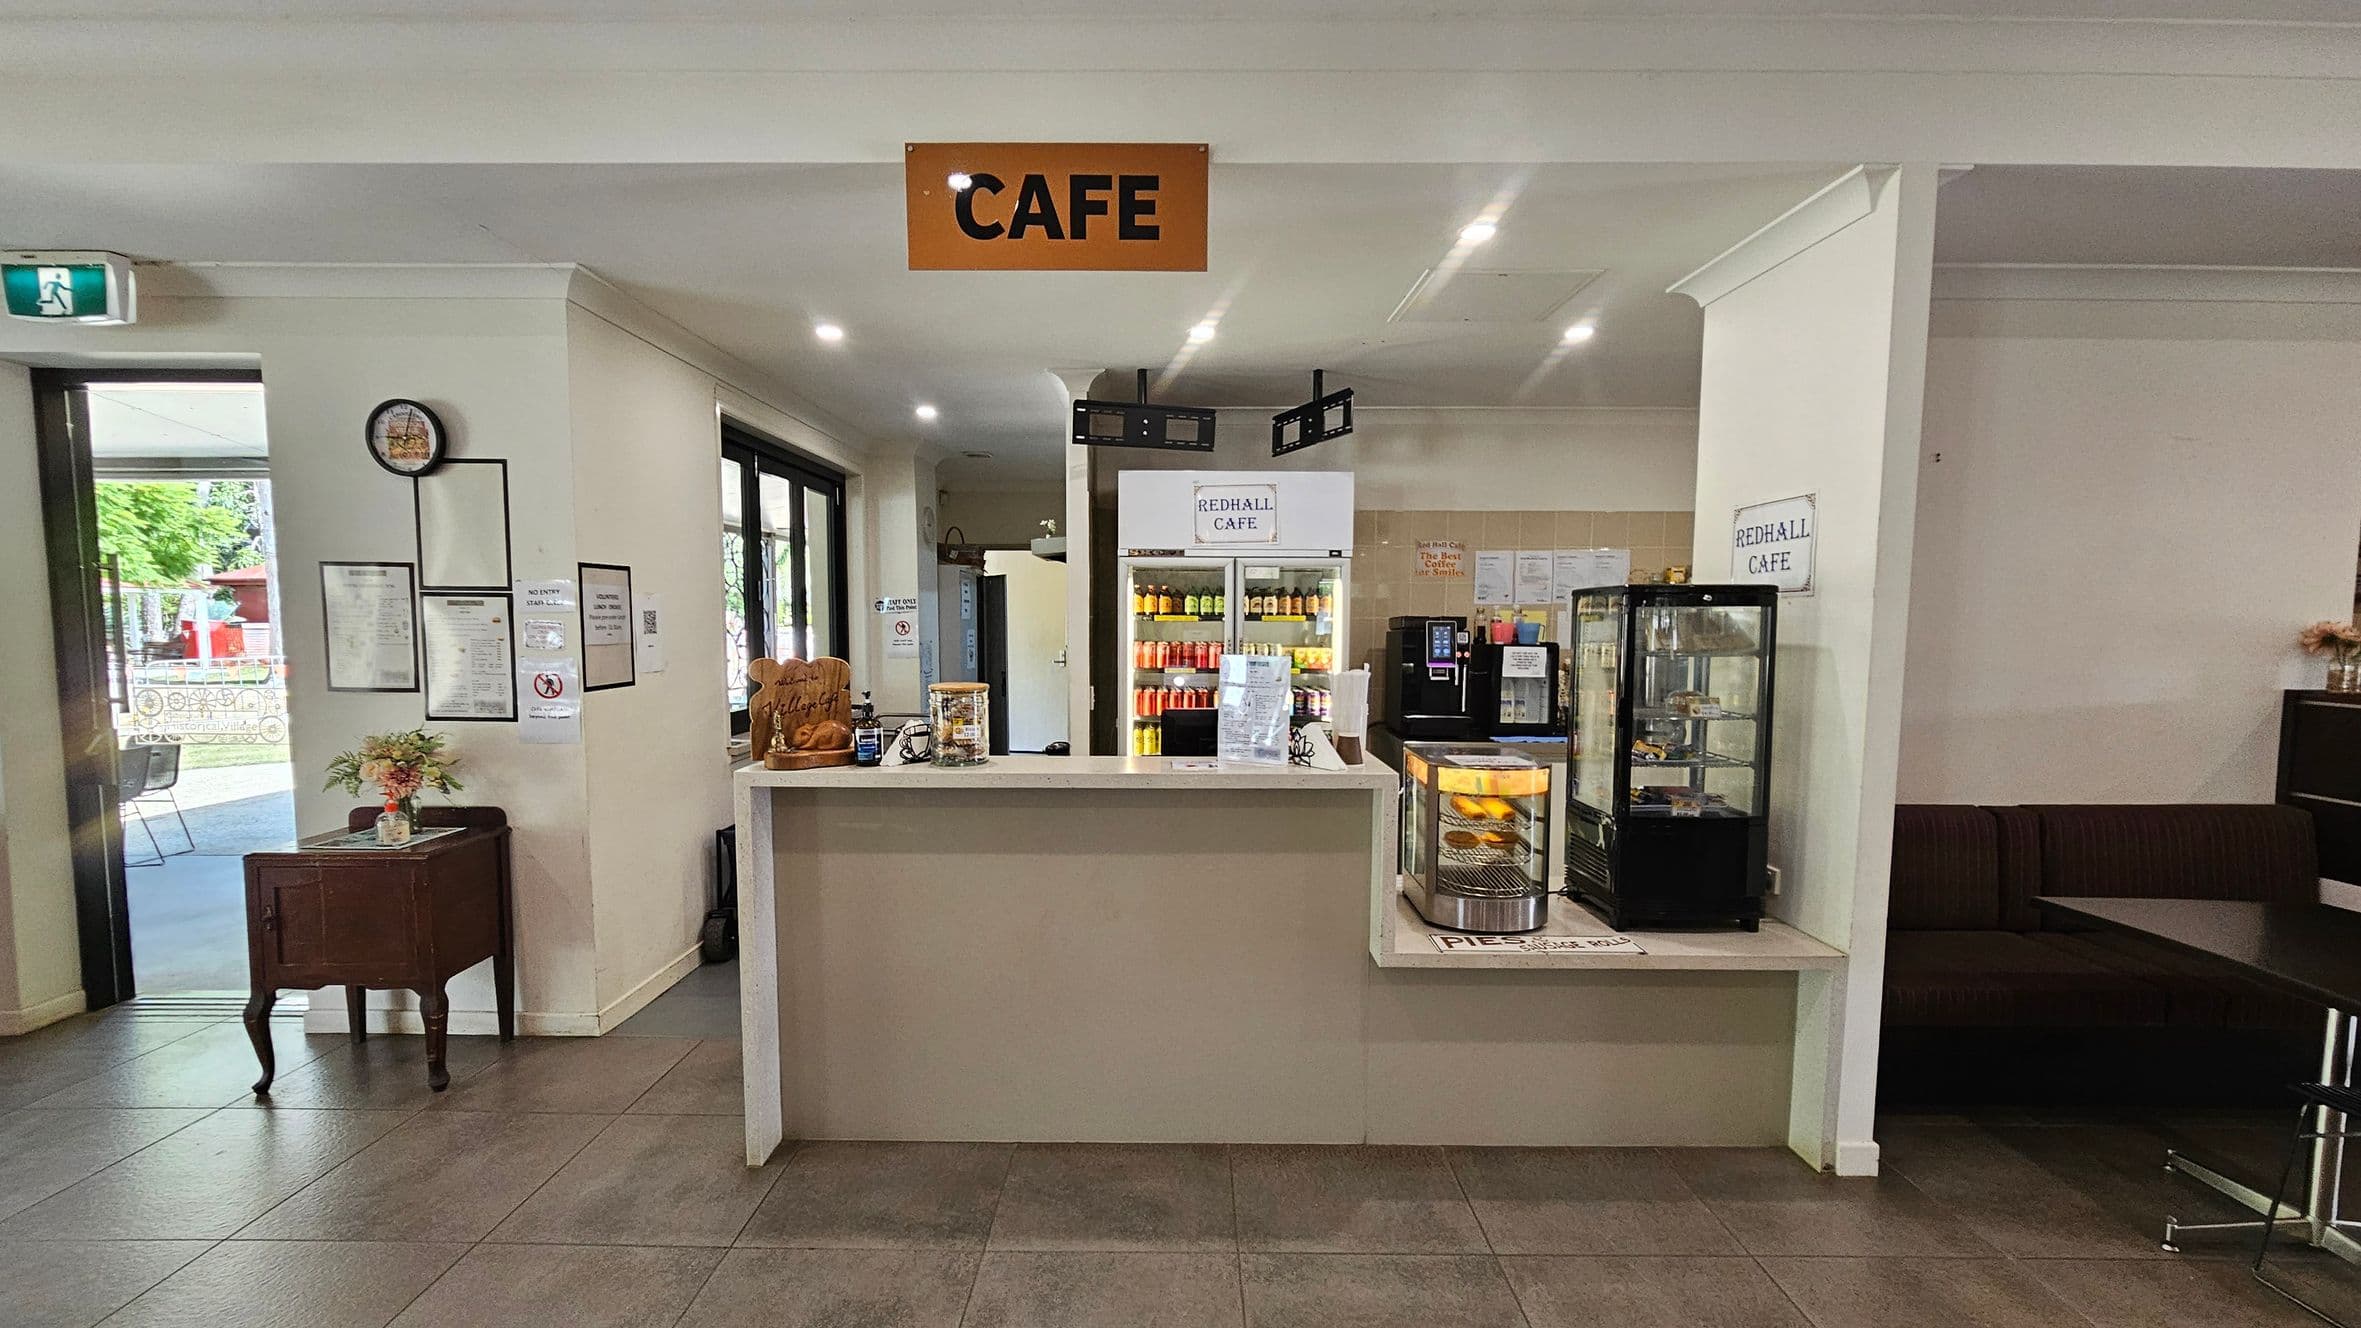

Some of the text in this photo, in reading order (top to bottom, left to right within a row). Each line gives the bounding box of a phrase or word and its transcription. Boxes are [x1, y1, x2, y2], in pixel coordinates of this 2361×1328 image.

[954, 172, 1160, 241] CAFE
[1198, 498, 1273, 512] REDHALL
[1214, 517, 1258, 530] CAFE
[1736, 518, 1810, 548] REDHALL
[1420, 551, 1461, 560] The Best
[1748, 551, 1791, 574] CAFE
[1424, 559, 1456, 568] Coffee
[1432, 568, 1465, 576] Smiles
[1439, 936, 1527, 949] PIES
[1519, 940, 1586, 952] SAUSAGE
[1587, 936, 1631, 949] ROLLS
